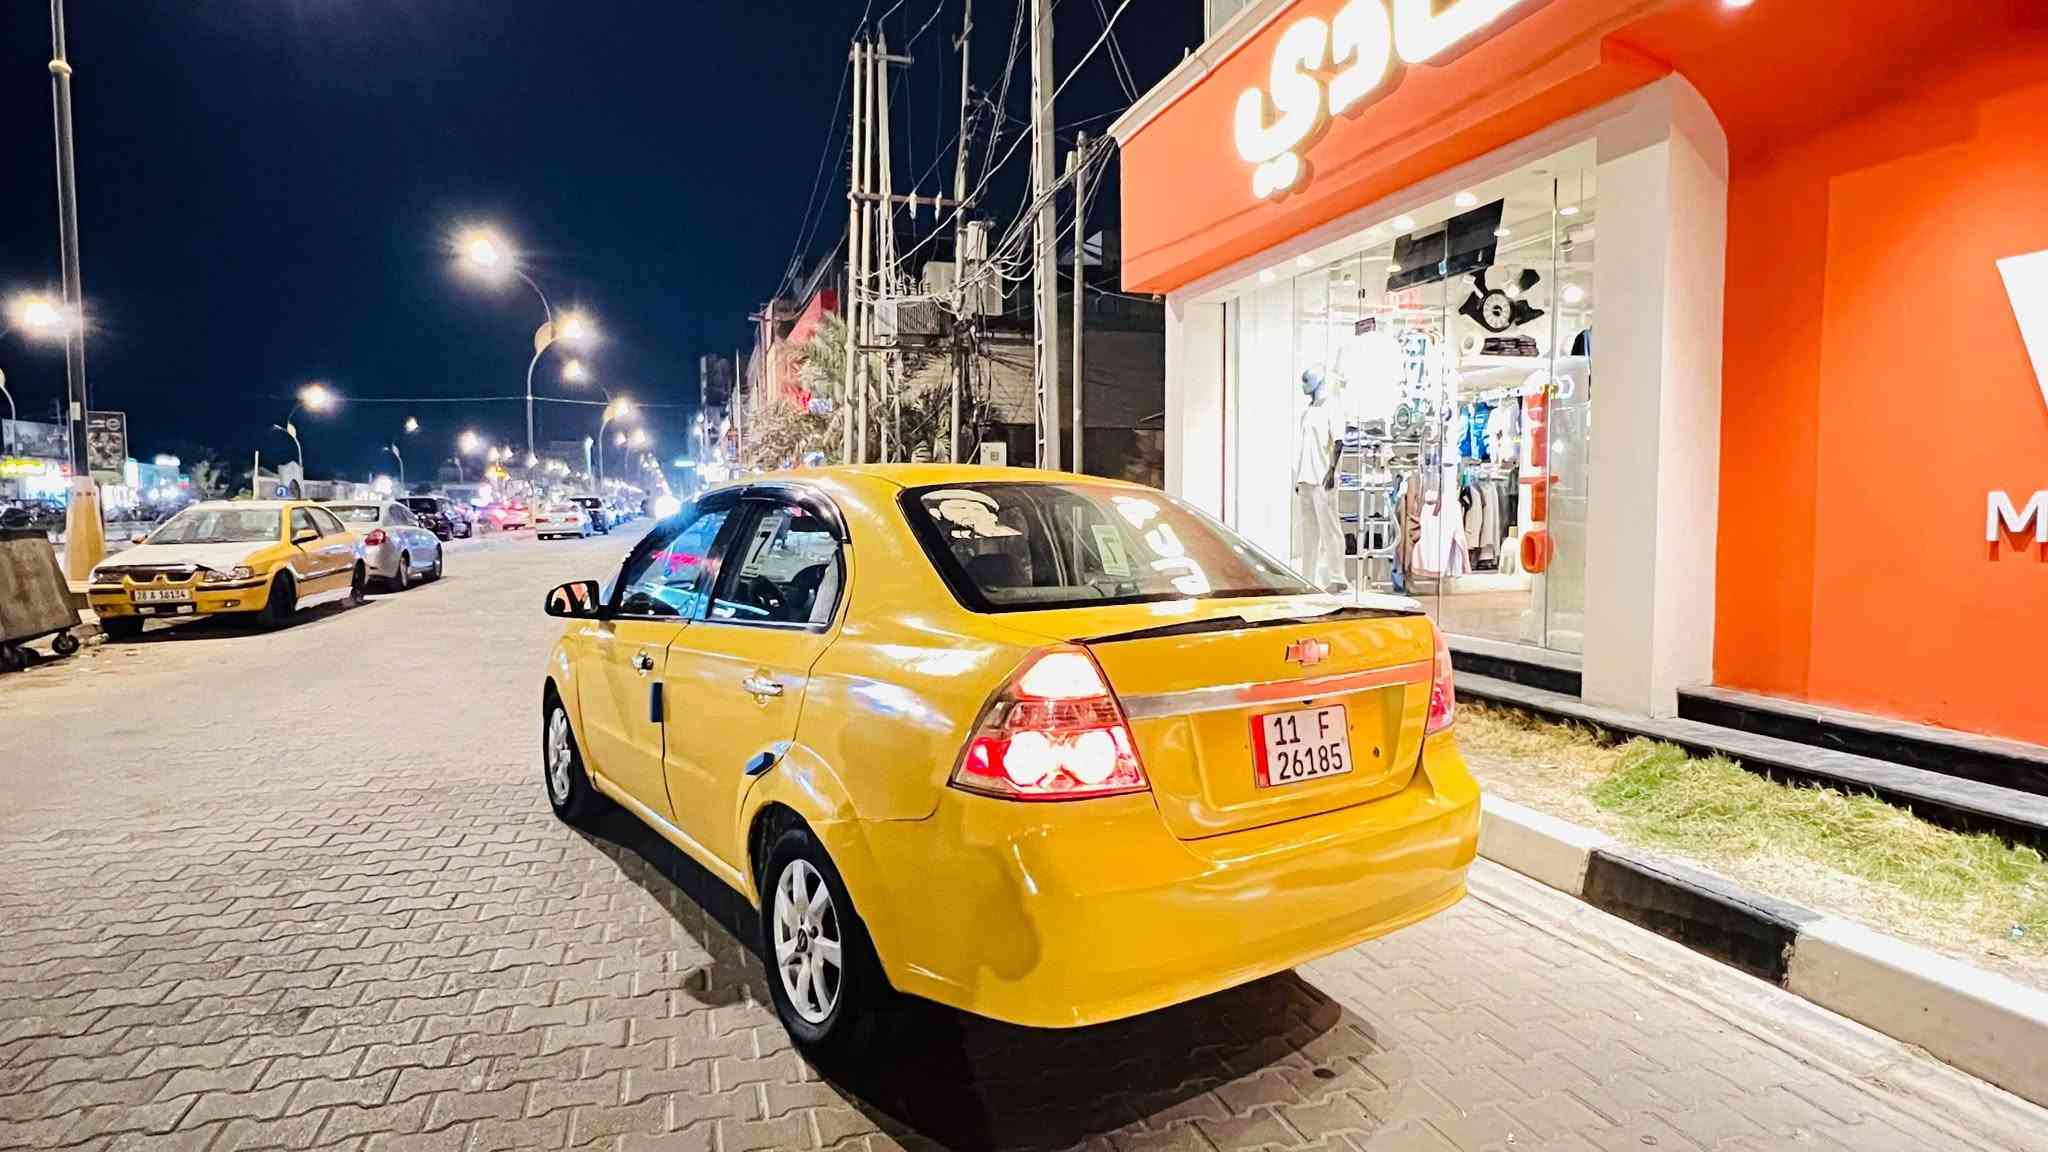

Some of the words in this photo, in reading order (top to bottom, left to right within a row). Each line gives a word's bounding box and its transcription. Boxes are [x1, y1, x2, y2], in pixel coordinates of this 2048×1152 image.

[1273, 715, 1301, 746] 11
[1317, 711, 1329, 739] F
[1277, 742, 1343, 781] 26185
